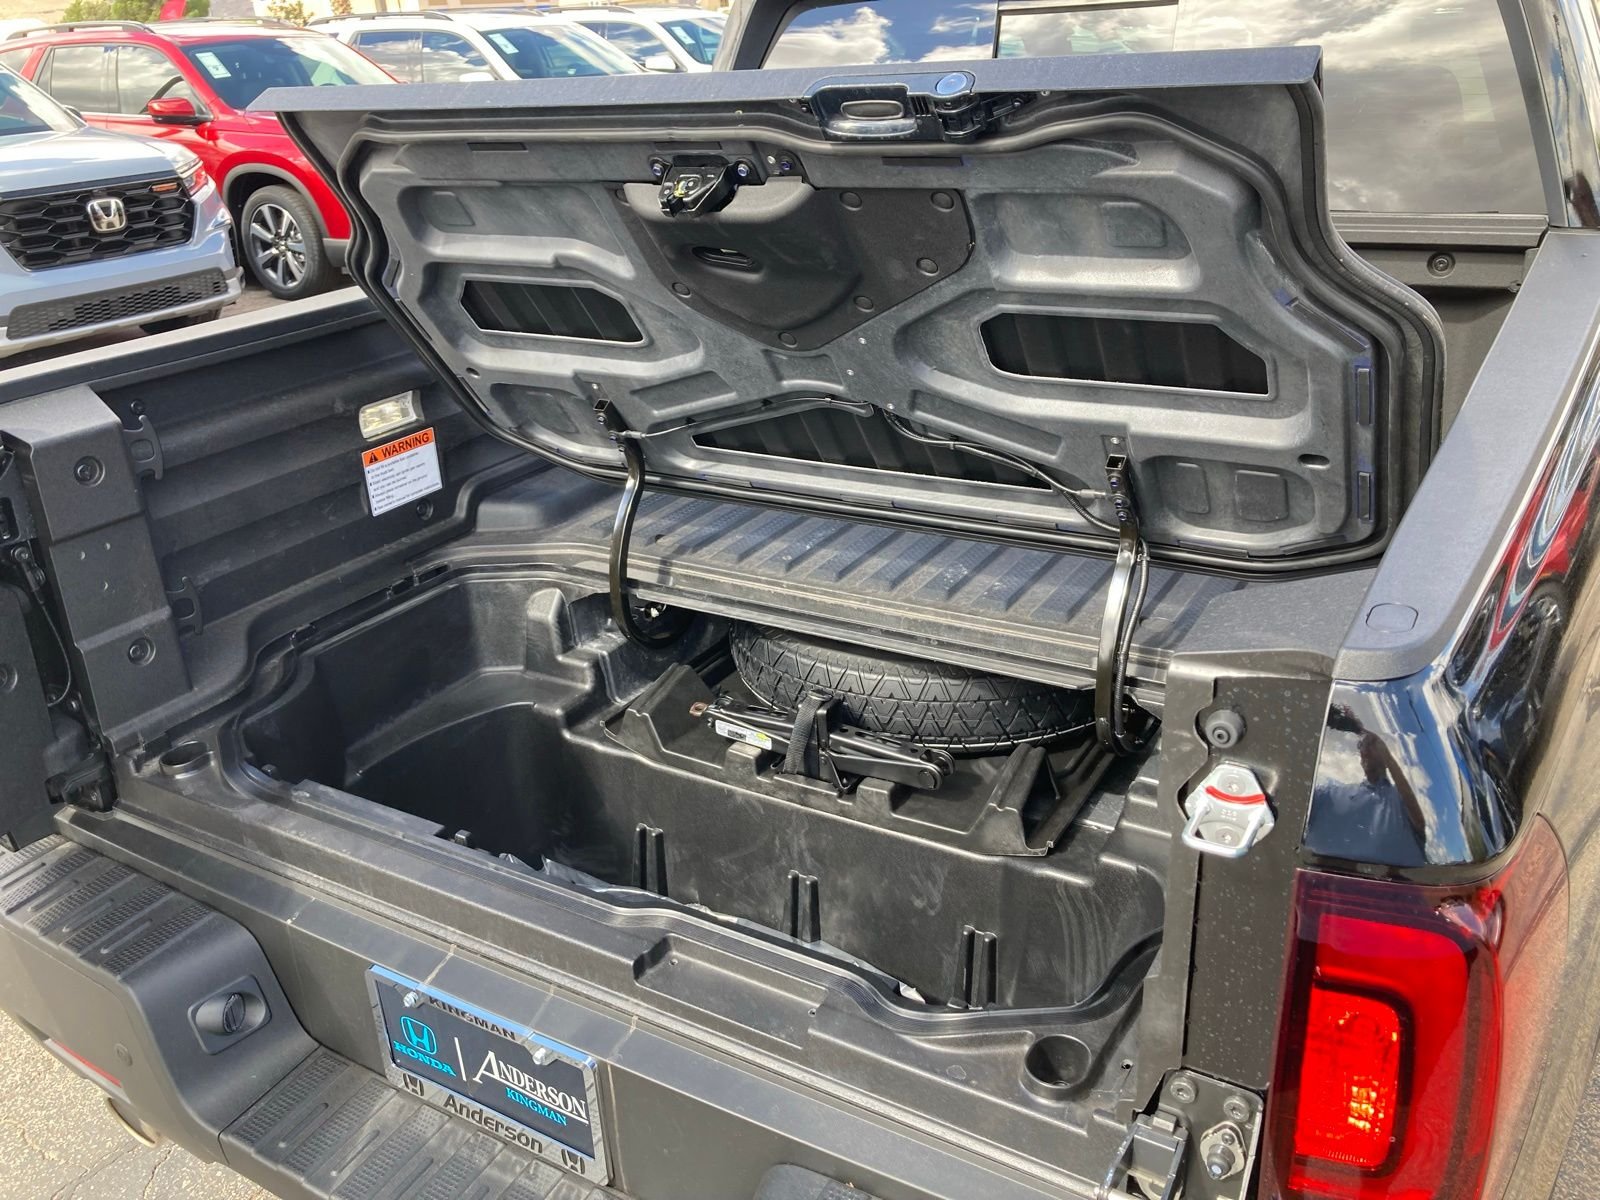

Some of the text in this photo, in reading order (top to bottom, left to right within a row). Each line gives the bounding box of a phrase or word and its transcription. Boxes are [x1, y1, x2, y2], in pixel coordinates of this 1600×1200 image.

[381, 432, 430, 458] WARNING
[429, 995, 516, 1041] KINGMAN
[393, 1039, 456, 1077] HONDA
[472, 1050, 588, 1119] ANDERSON
[443, 1094, 543, 1153] Anderson
[505, 1087, 567, 1126] KINGMAN
